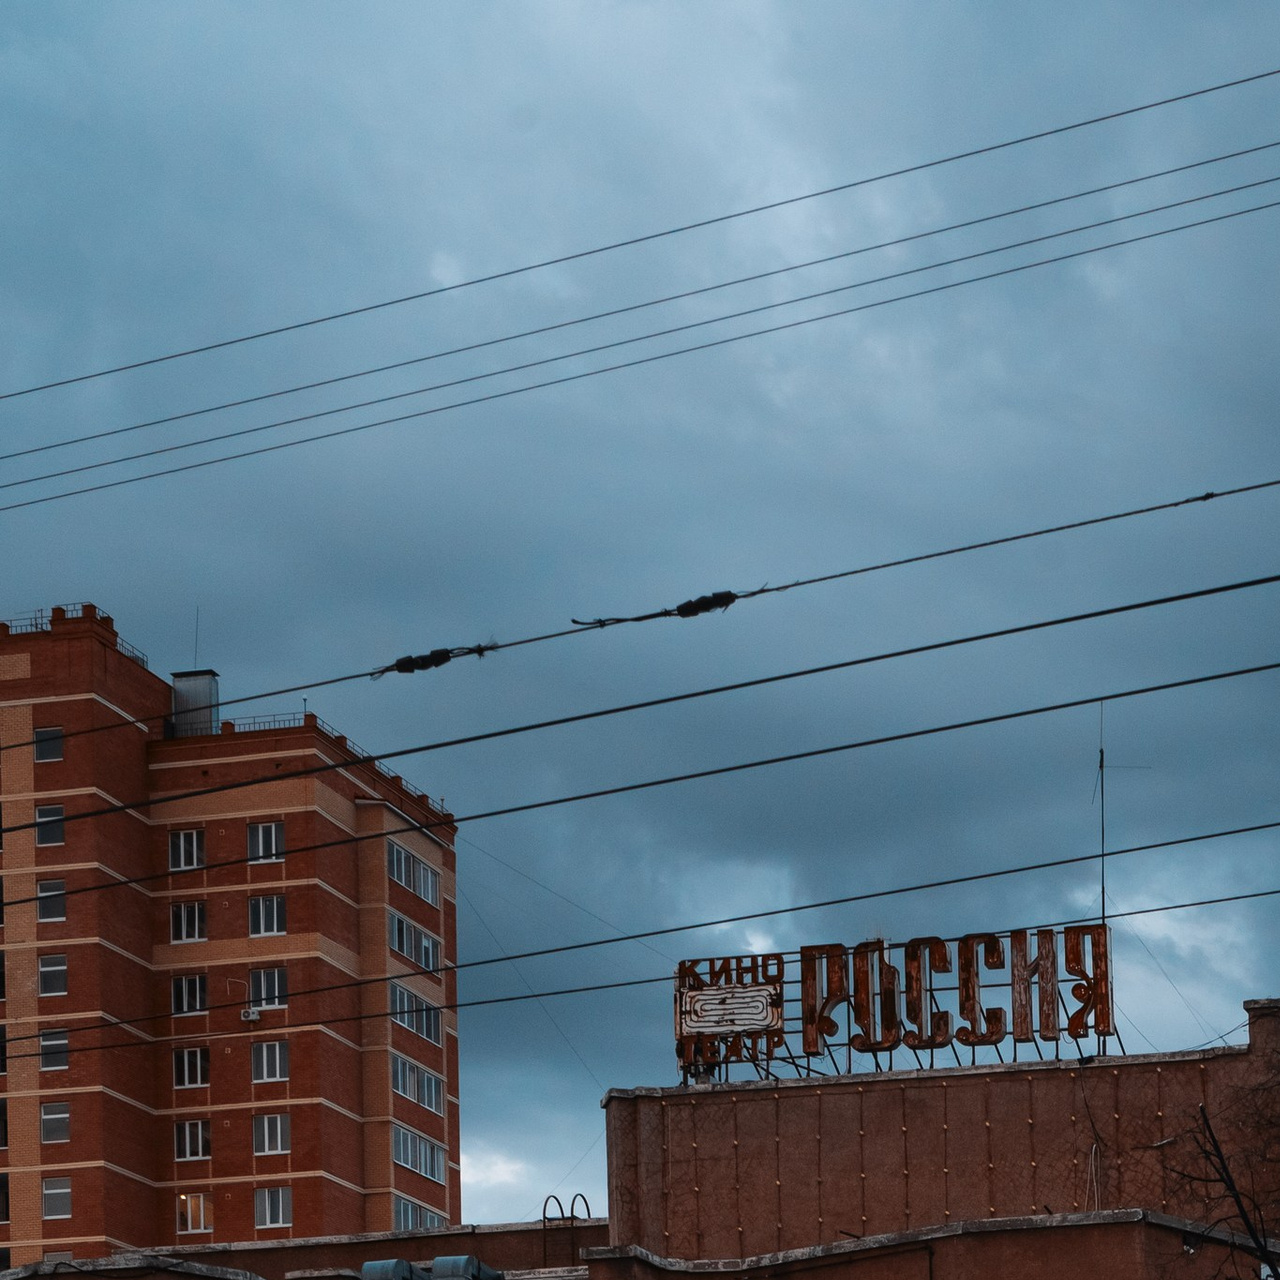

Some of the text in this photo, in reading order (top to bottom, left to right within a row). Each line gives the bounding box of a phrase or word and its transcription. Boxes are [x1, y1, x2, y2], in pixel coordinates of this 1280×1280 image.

[679, 954, 784, 990] КИНО
[801, 924, 1115, 1056] РОССИЯ
[679, 1029, 784, 1064] ТЕАТР
